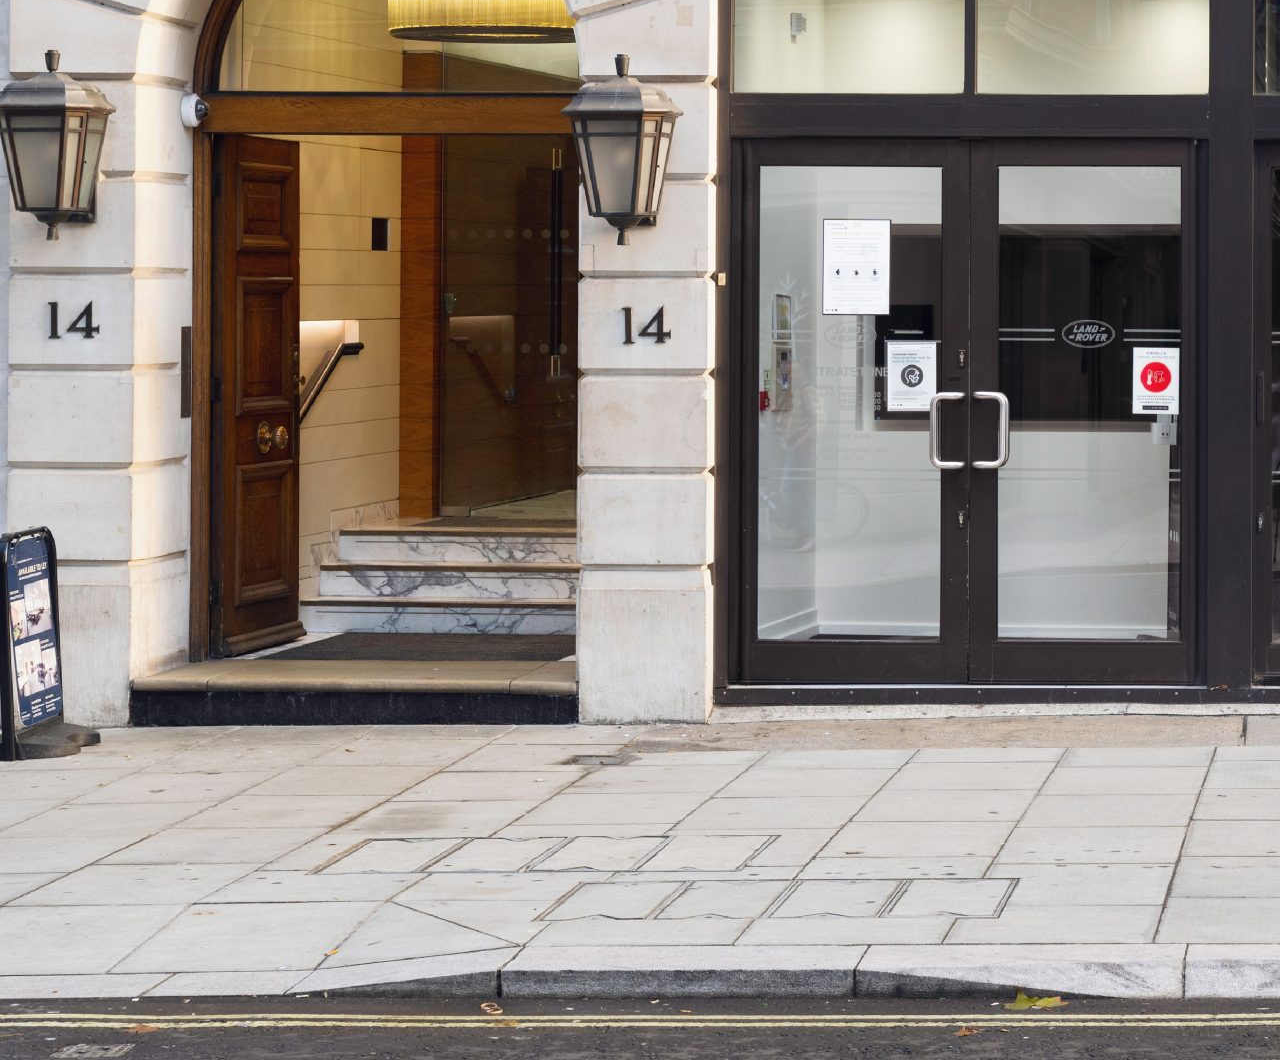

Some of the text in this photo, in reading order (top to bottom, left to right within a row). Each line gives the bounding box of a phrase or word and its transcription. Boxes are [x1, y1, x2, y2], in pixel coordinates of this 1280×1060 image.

[47, 300, 100, 340] 14
[621, 305, 672, 344] 14
[1073, 325, 1099, 333] LAND
[1075, 333, 1108, 341] ROVER
